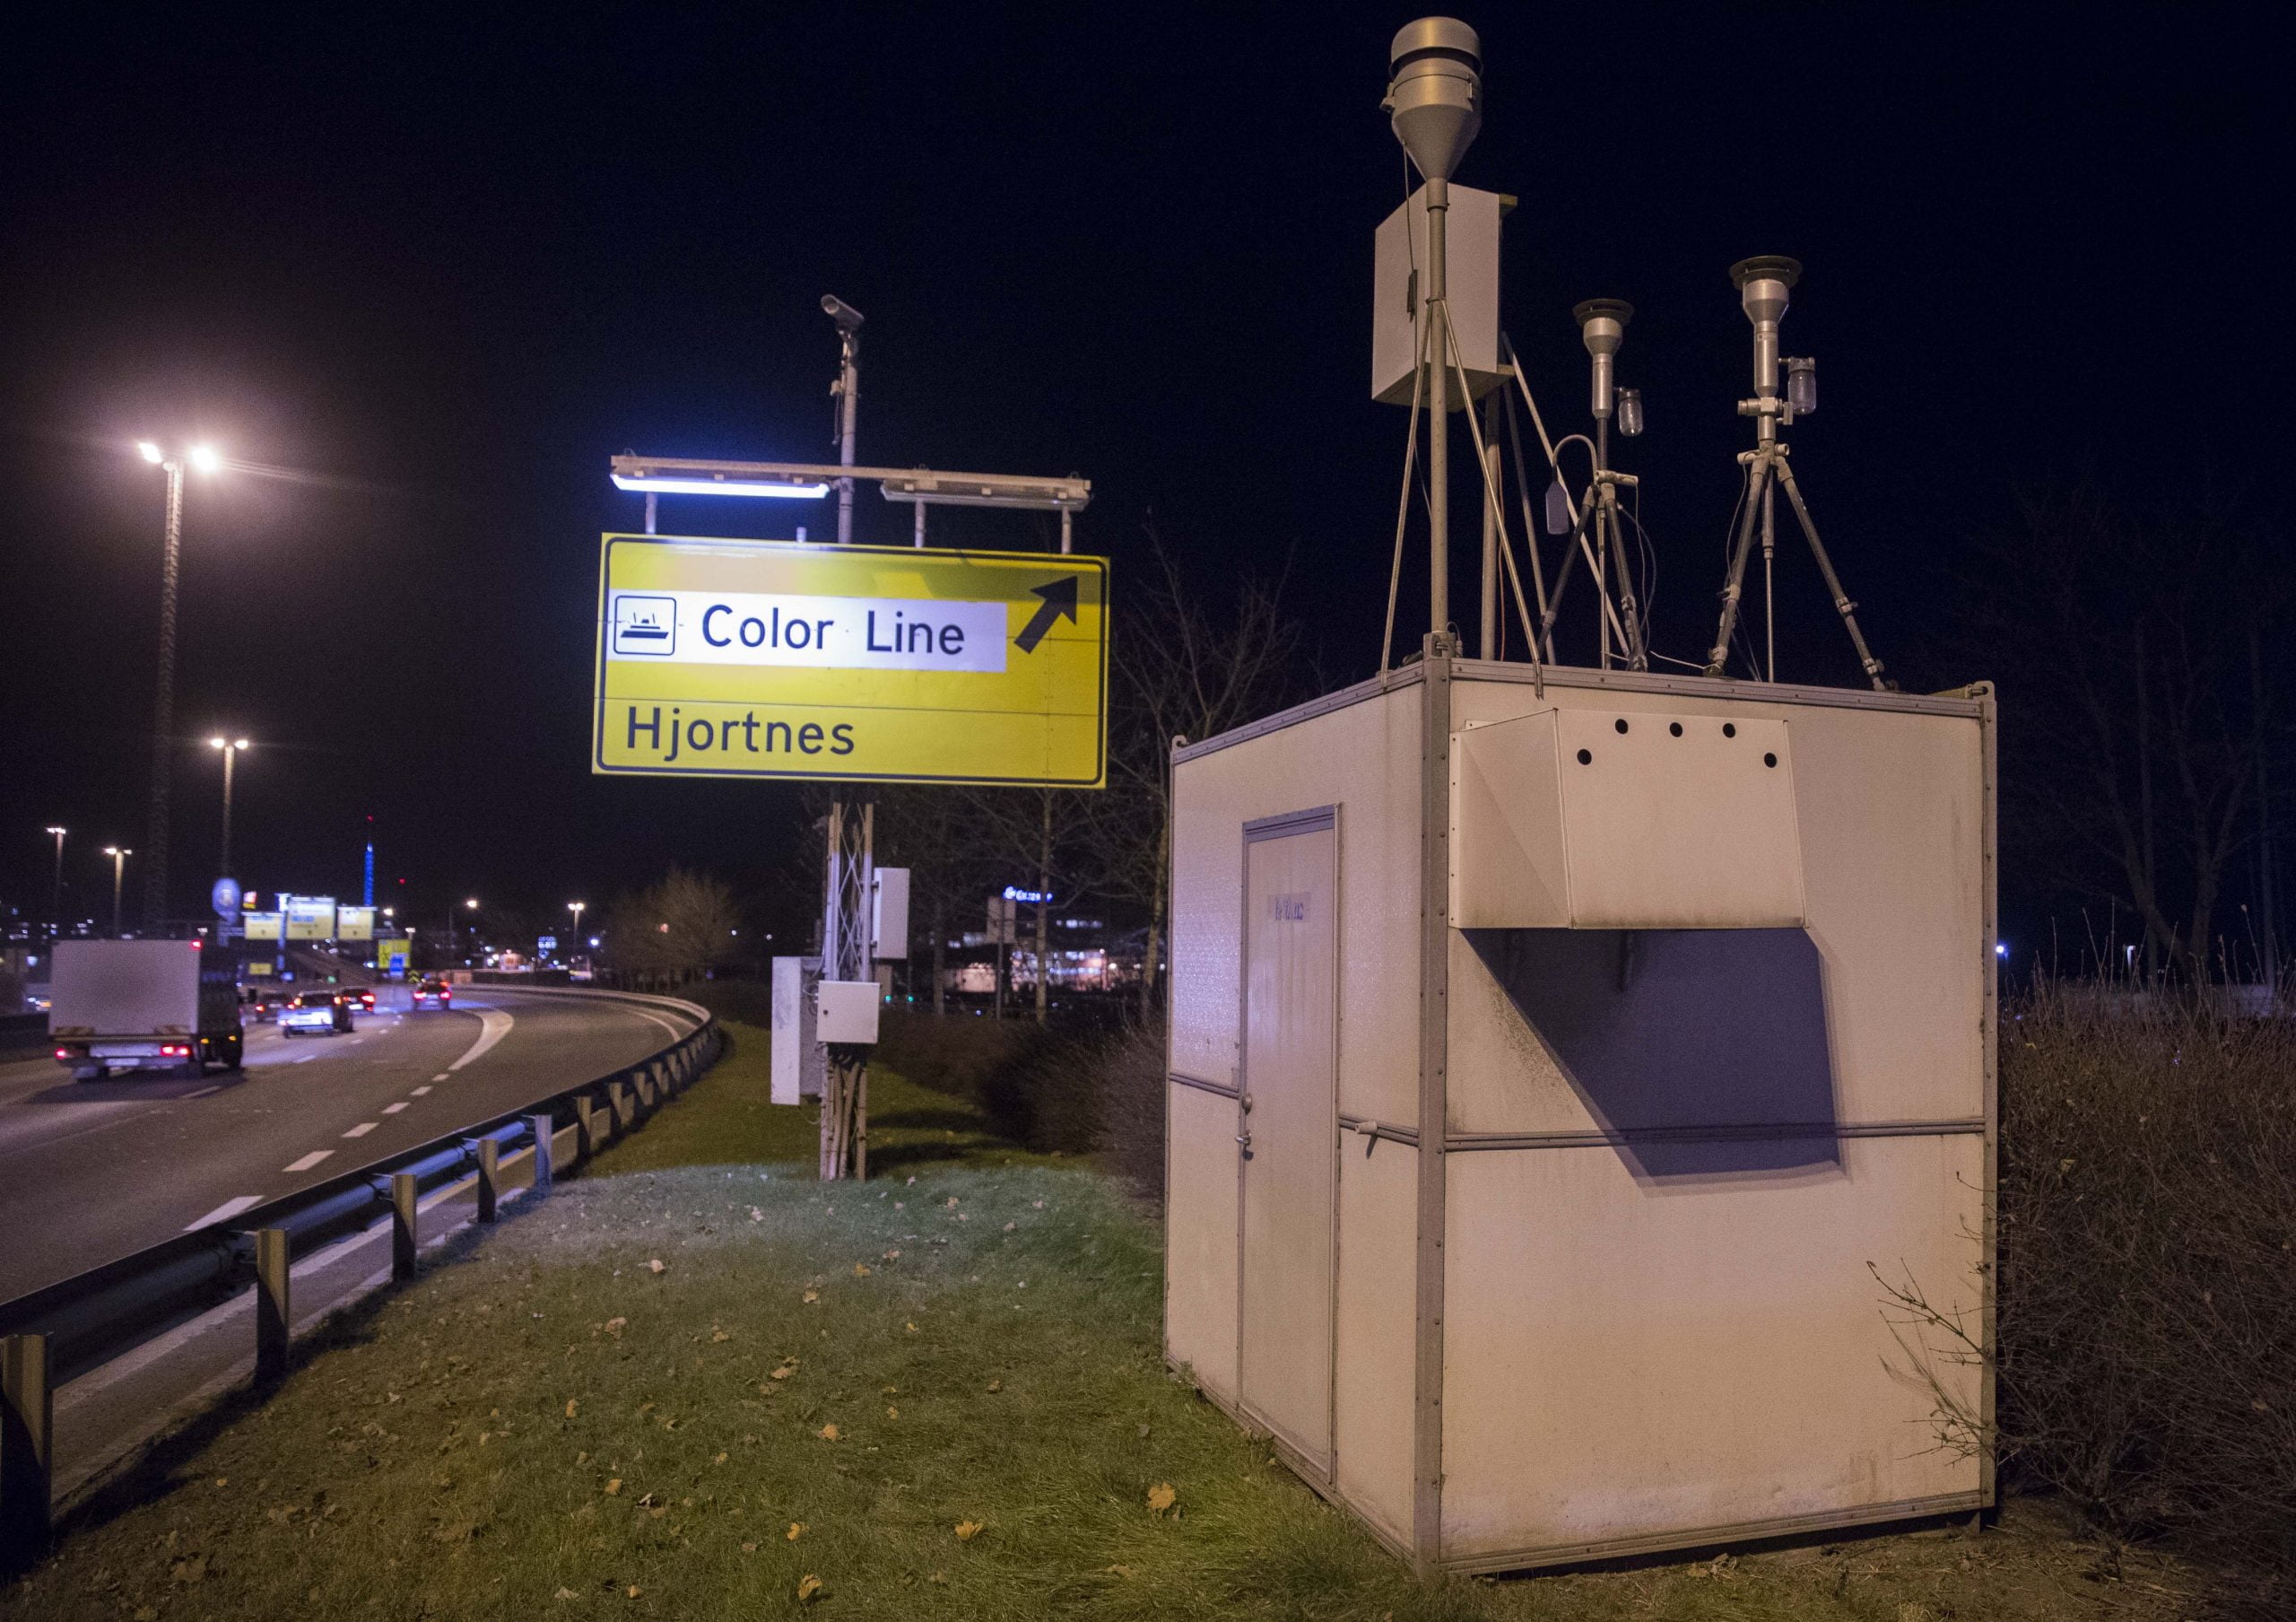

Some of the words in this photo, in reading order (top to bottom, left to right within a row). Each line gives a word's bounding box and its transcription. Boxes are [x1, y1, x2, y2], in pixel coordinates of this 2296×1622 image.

[702, 604, 834, 650] Color
[866, 609, 965, 655] Line
[626, 705, 855, 763] Hjortnes
